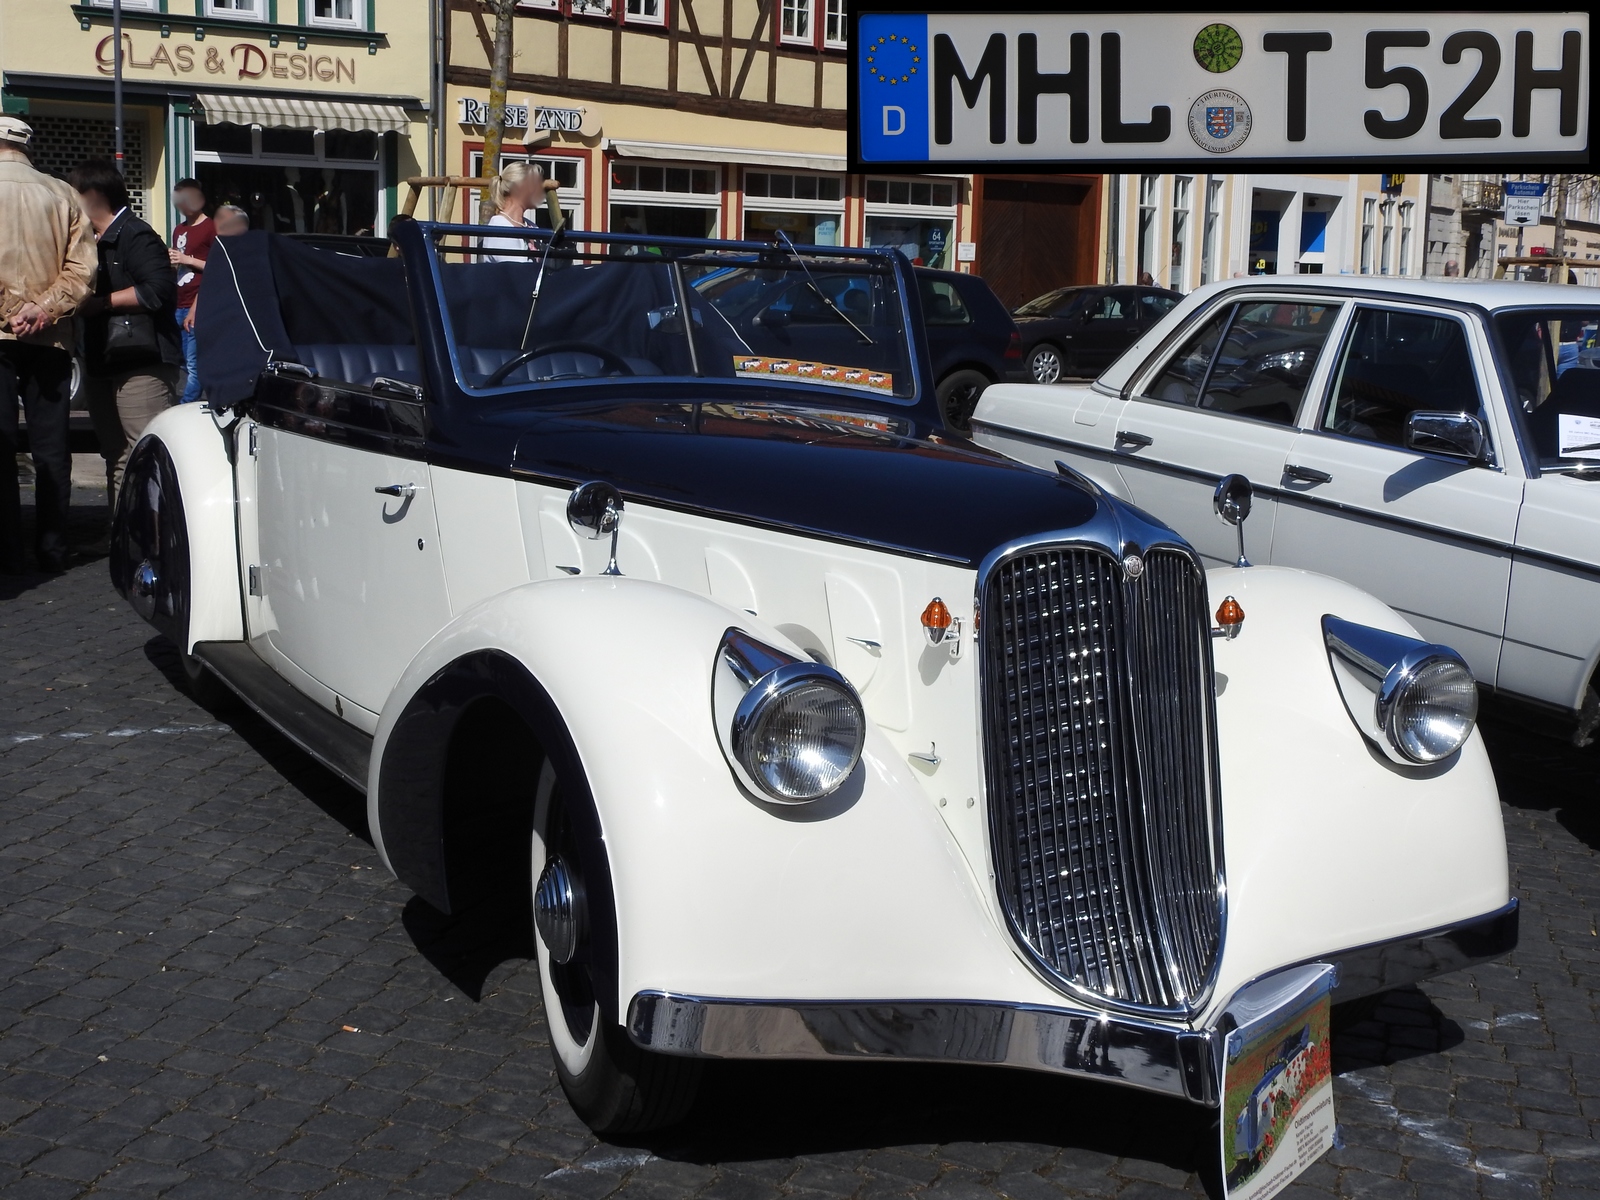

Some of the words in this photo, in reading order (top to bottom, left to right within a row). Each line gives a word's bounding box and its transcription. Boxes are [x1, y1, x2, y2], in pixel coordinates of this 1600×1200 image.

[95, 32, 195, 76] GLAS
[204, 45, 225, 73] &
[230, 43, 356, 84] DESIGN
[933, 32, 1171, 144] MHL
[1263, 31, 1332, 142] T
[1363, 29, 1581, 140] 52H
[882, 105, 905, 136] D
[932, 231, 941, 241] 64
